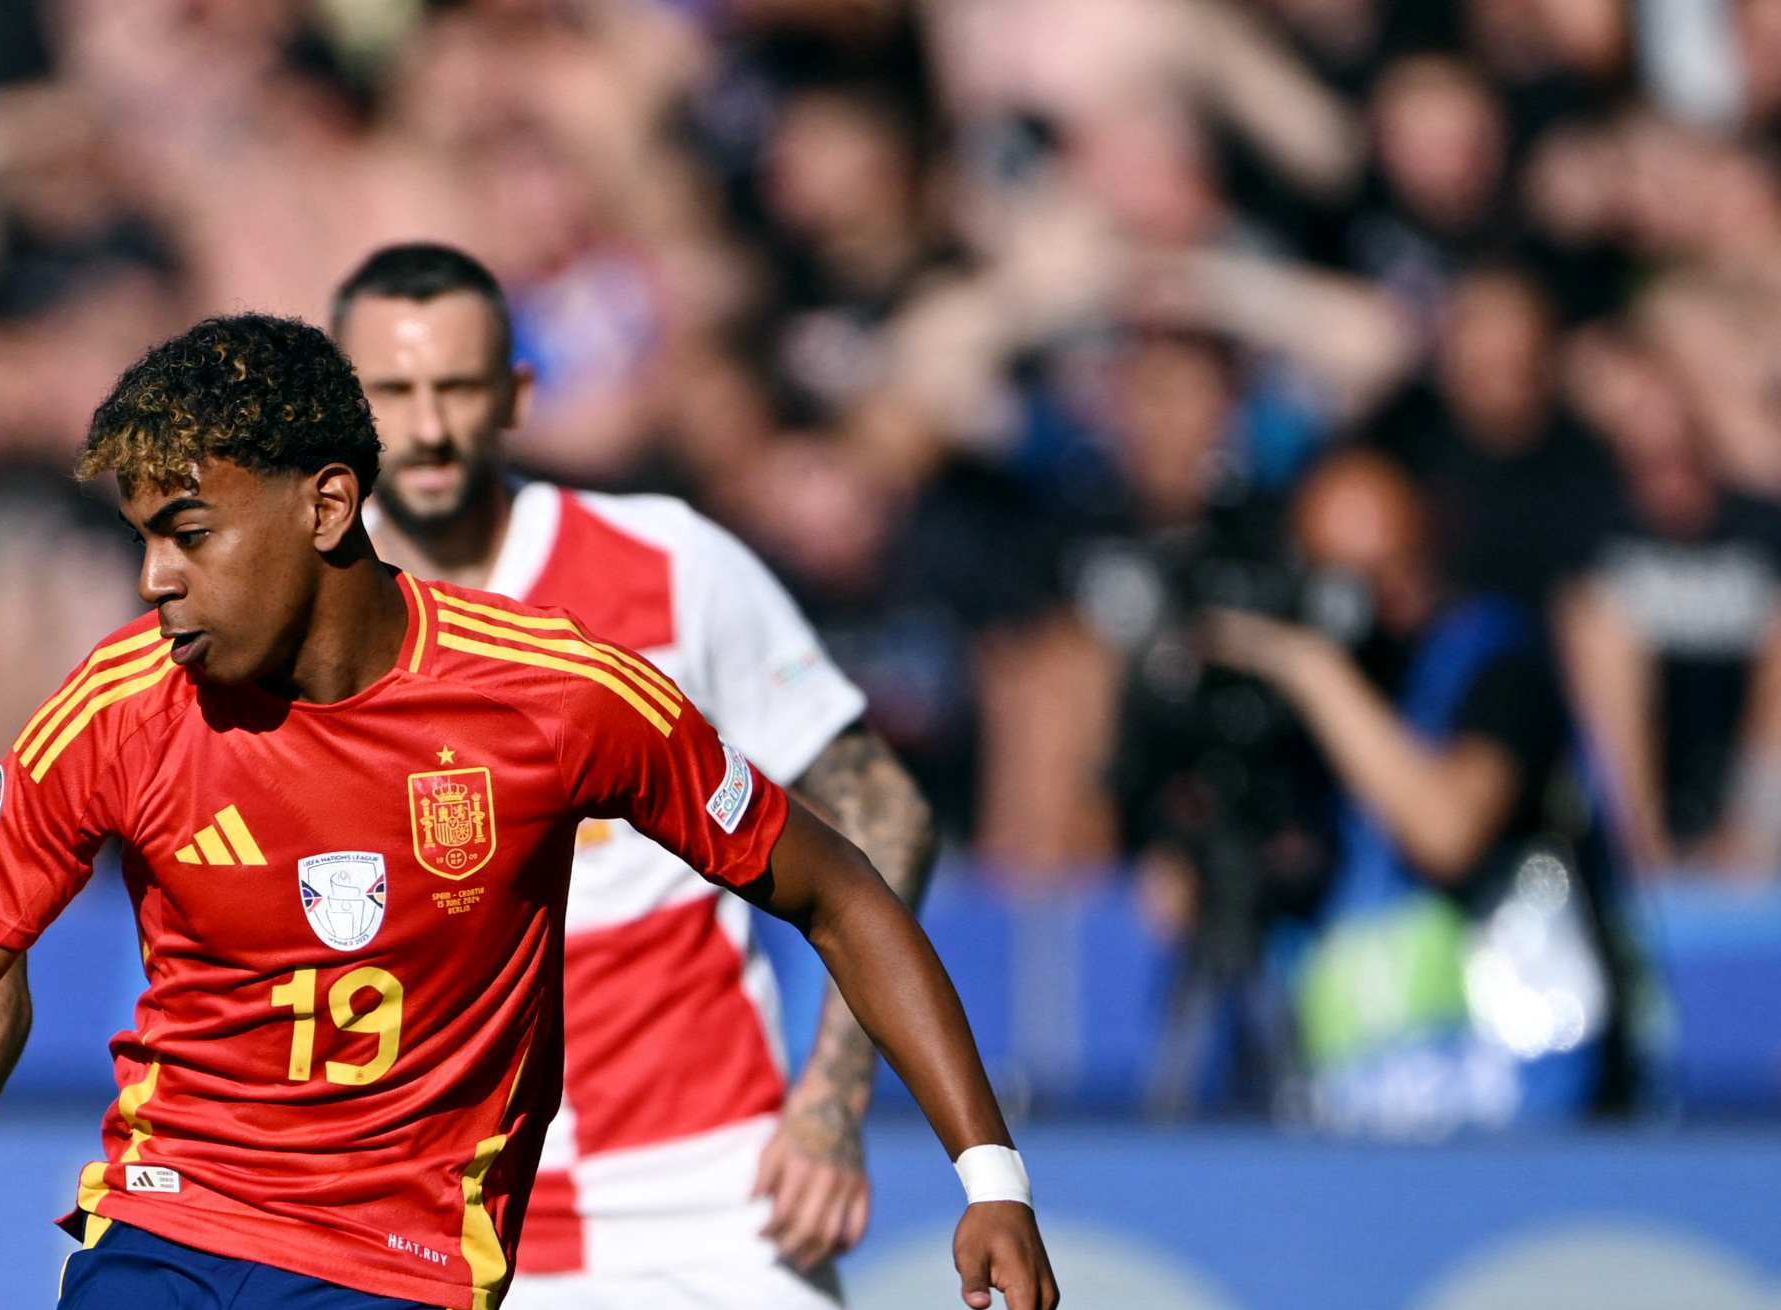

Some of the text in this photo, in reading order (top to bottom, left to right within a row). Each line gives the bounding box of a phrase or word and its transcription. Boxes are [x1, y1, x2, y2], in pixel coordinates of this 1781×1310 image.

[710, 788, 727, 812] UEFA
[303, 859, 320, 867] UEFA
[448, 905, 470, 915] BERLIN
[271, 965, 404, 1086] 19
[387, 1233, 448, 1266] HEAT.RDY
